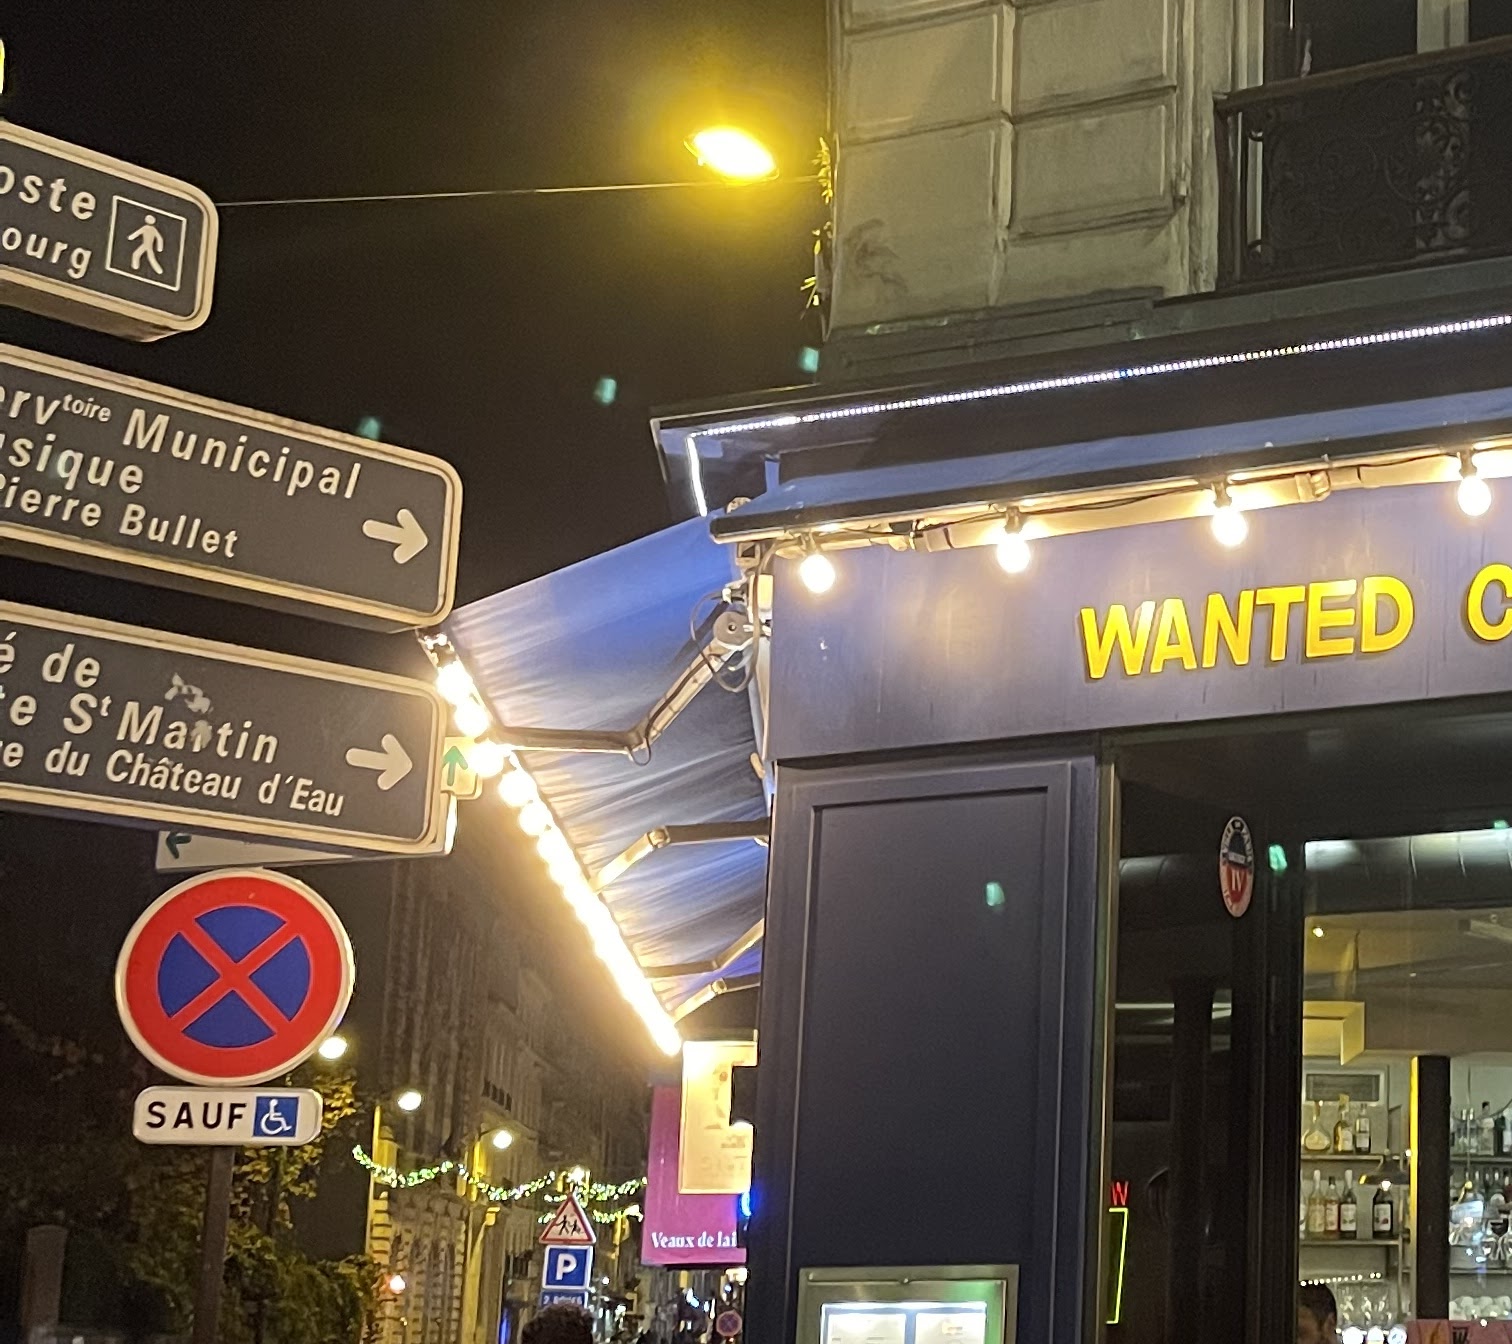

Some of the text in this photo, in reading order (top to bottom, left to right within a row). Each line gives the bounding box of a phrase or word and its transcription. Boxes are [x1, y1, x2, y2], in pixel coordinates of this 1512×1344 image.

[2, 227, 92, 279] ourg
[0, 386, 361, 499] rvtoire Municipal
[0, 433, 144, 494] sique
[119, 504, 238, 558] Bullet
[1081, 575, 1415, 679] WANTED
[42, 643, 100, 688] de
[63, 692, 112, 734] St
[116, 701, 278, 764] Martin
[45, 741, 90, 776] du
[106, 749, 242, 799] Château
[258, 773, 344, 816] d'Eau
[145, 1101, 249, 1130] SAUF
[651, 1231, 695, 1249] Veaux
[697, 1230, 715, 1248] de
[555, 1253, 577, 1281] P
